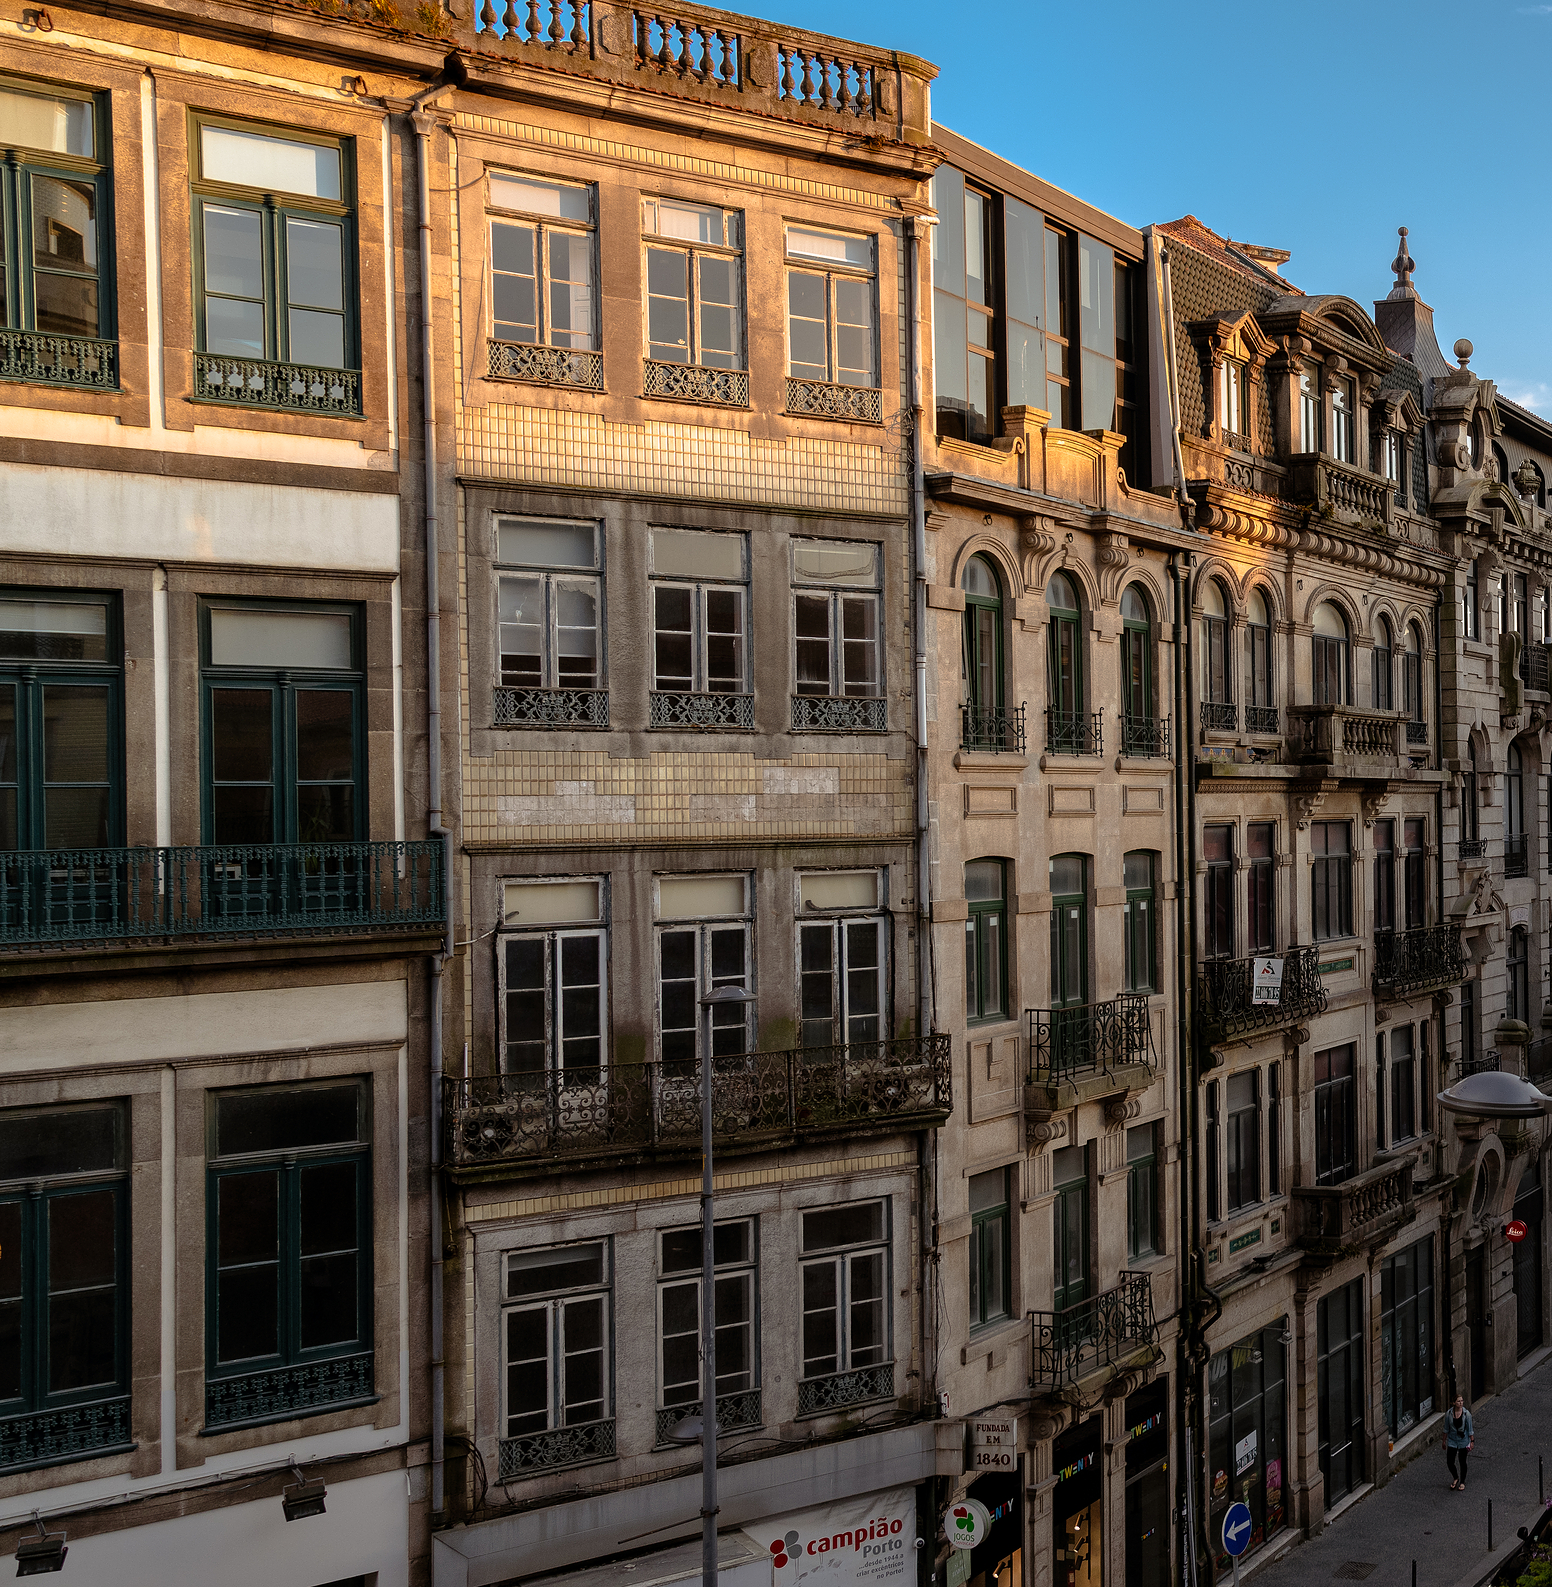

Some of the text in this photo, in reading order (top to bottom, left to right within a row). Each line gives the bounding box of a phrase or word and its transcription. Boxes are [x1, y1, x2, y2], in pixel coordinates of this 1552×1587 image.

[1506, 1226, 1523, 1237] Leica
[976, 1424, 1010, 1434] FUNDADA
[1131, 1412, 1161, 1440] TWENTY
[986, 1436, 1001, 1444] EM
[976, 1453, 1011, 1466] 1840
[1059, 1452, 1094, 1482] TWENTY
[990, 1498, 1014, 1523] ENTY
[807, 1517, 903, 1555] campião
[953, 1533, 975, 1542] JOGOS
[863, 1539, 903, 1559] Porto
[884, 1554, 899, 1562] 1944
[885, 1567, 904, 1577] Porto!
